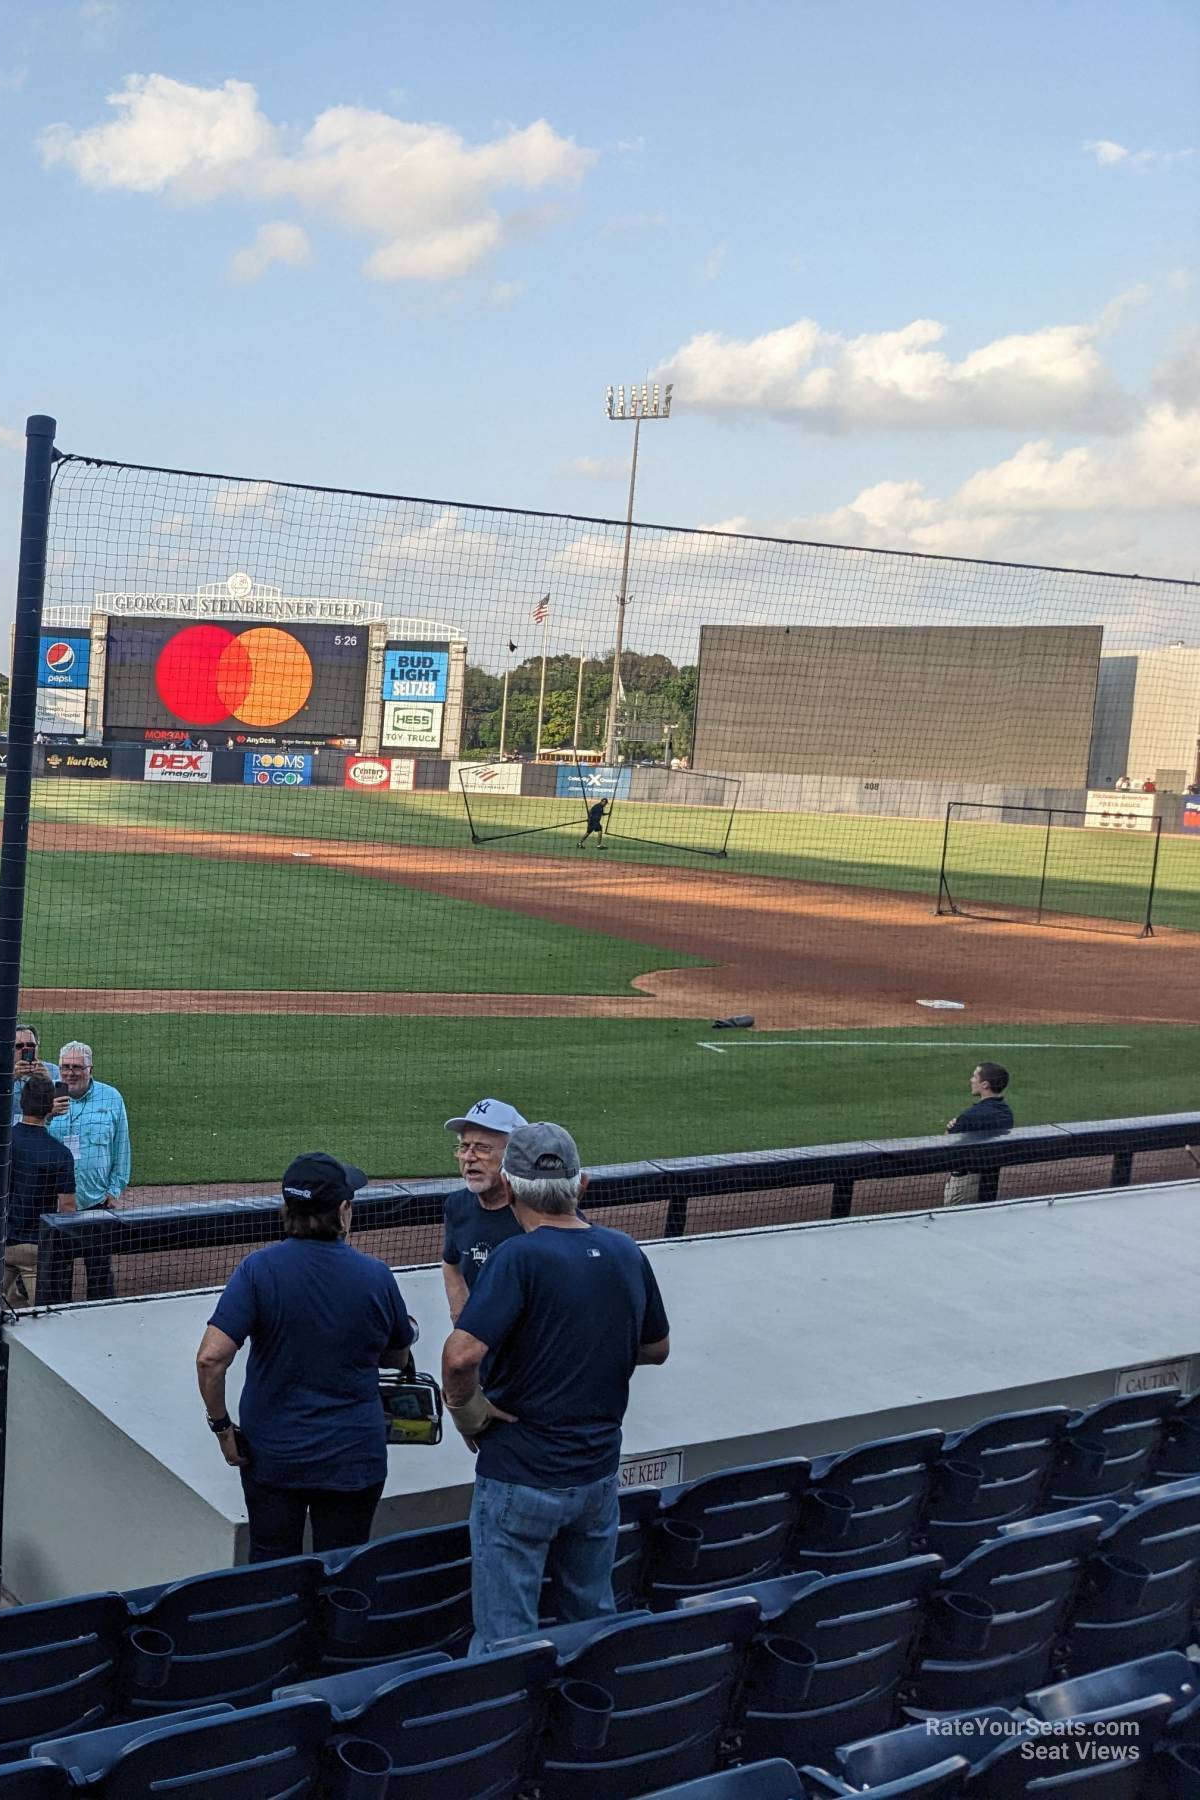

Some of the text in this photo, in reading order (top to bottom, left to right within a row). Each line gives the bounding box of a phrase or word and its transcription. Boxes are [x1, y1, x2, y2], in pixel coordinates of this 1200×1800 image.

[115, 596, 174, 611] GEORGE
[201, 599, 313, 616] STEINBRENNER
[319, 602, 361, 616] FIELD
[334, 635, 357, 646] 5:26
[397, 655, 434, 669] BUD
[390, 668, 440, 682] LIGHT
[393, 680, 436, 697] SELTZER
[396, 714, 430, 725] HESS
[246, 736, 277, 745] AnyDesk
[386, 733, 437, 743] TOY TRUCK
[66, 756, 108, 769] Hard Rock
[149, 753, 203, 771] DEX
[252, 753, 305, 769] ROOMS
[161, 768, 208, 779] imaging
[252, 771, 297, 785] TO GO
[352, 766, 385, 778] Century
[472, 1101, 492, 1115] NY
[1126, 1370, 1181, 1394] CAUTION
[638, 1461, 668, 1484] KEEP
